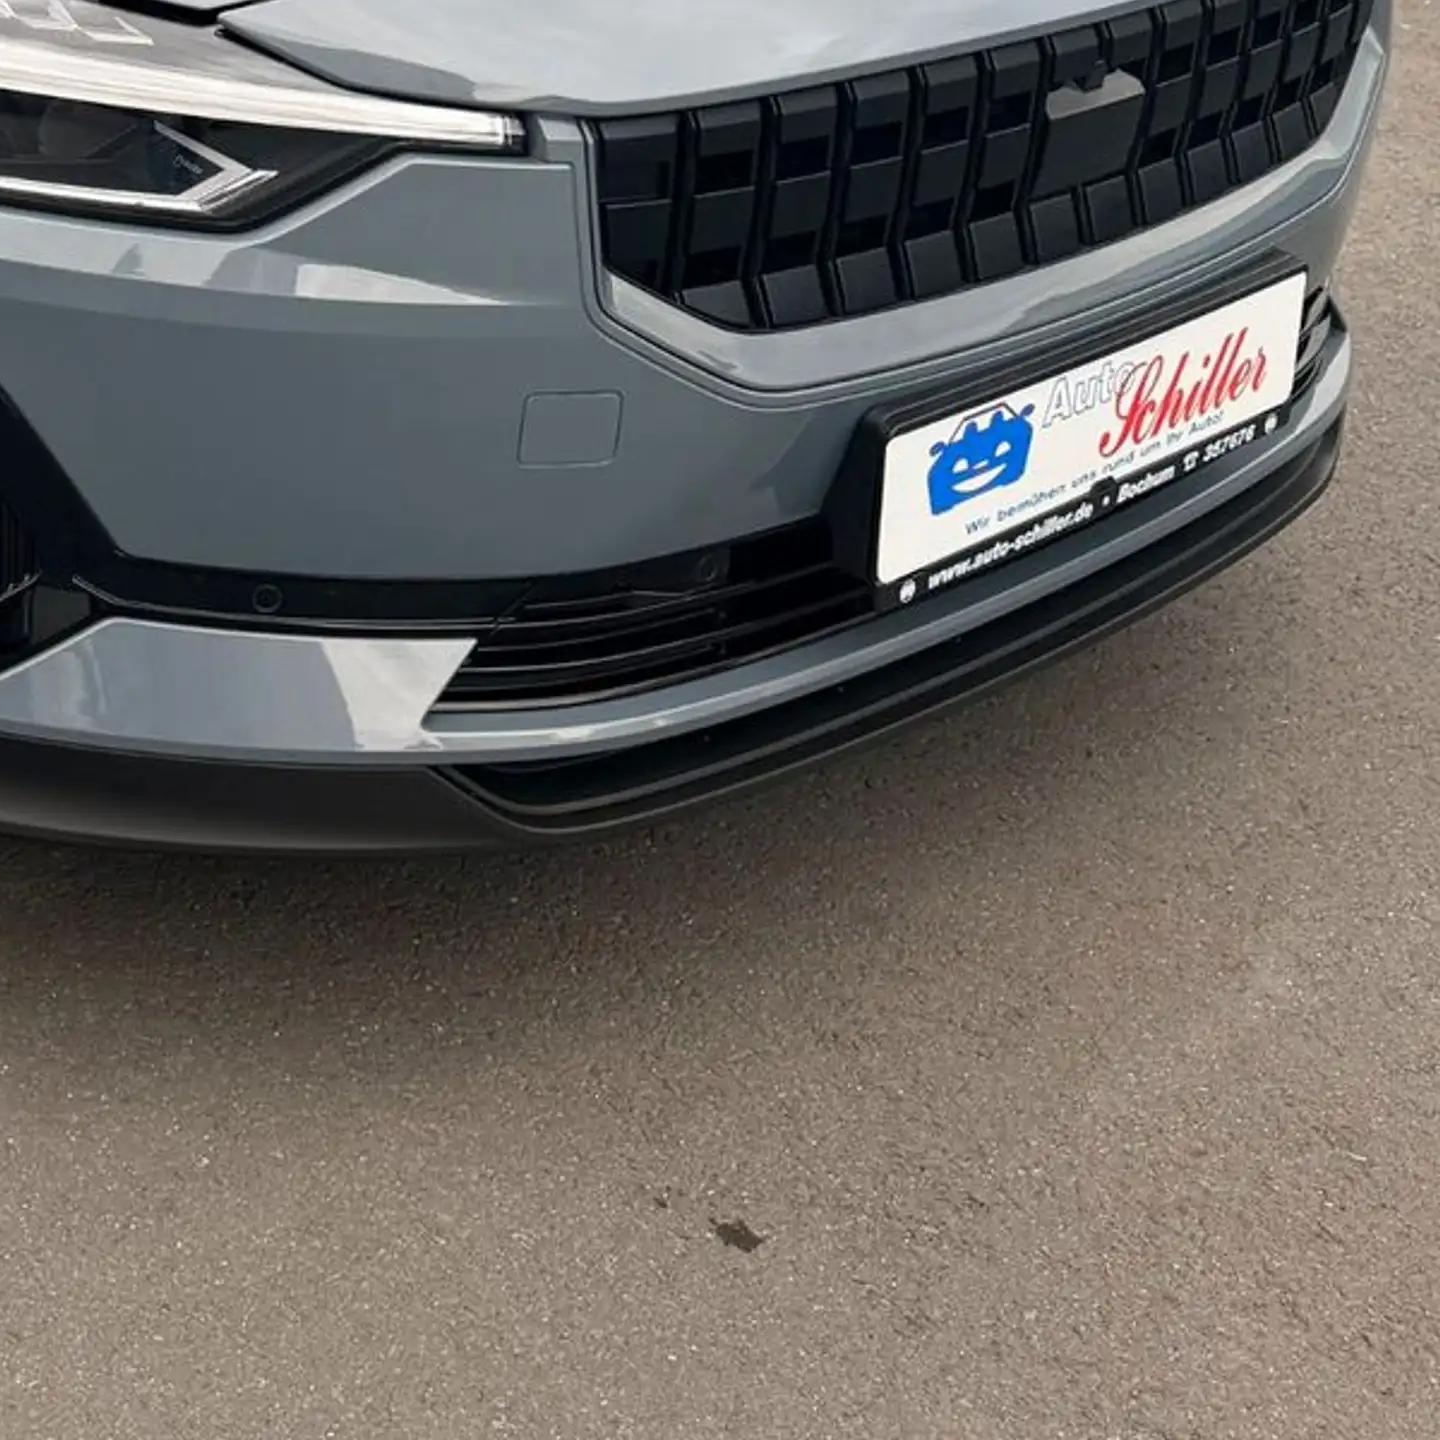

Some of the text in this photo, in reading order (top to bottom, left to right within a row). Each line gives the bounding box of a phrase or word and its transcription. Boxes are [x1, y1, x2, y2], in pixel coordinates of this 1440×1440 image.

[1042, 327, 1268, 458] Auto Schiller
[927, 501, 1095, 590] www.auto-schiller.de
[1116, 465, 1176, 504] Bochum
[964, 514, 990, 536] Wir
[1070, 470, 1097, 489] uns
[1101, 450, 1135, 475] rund
